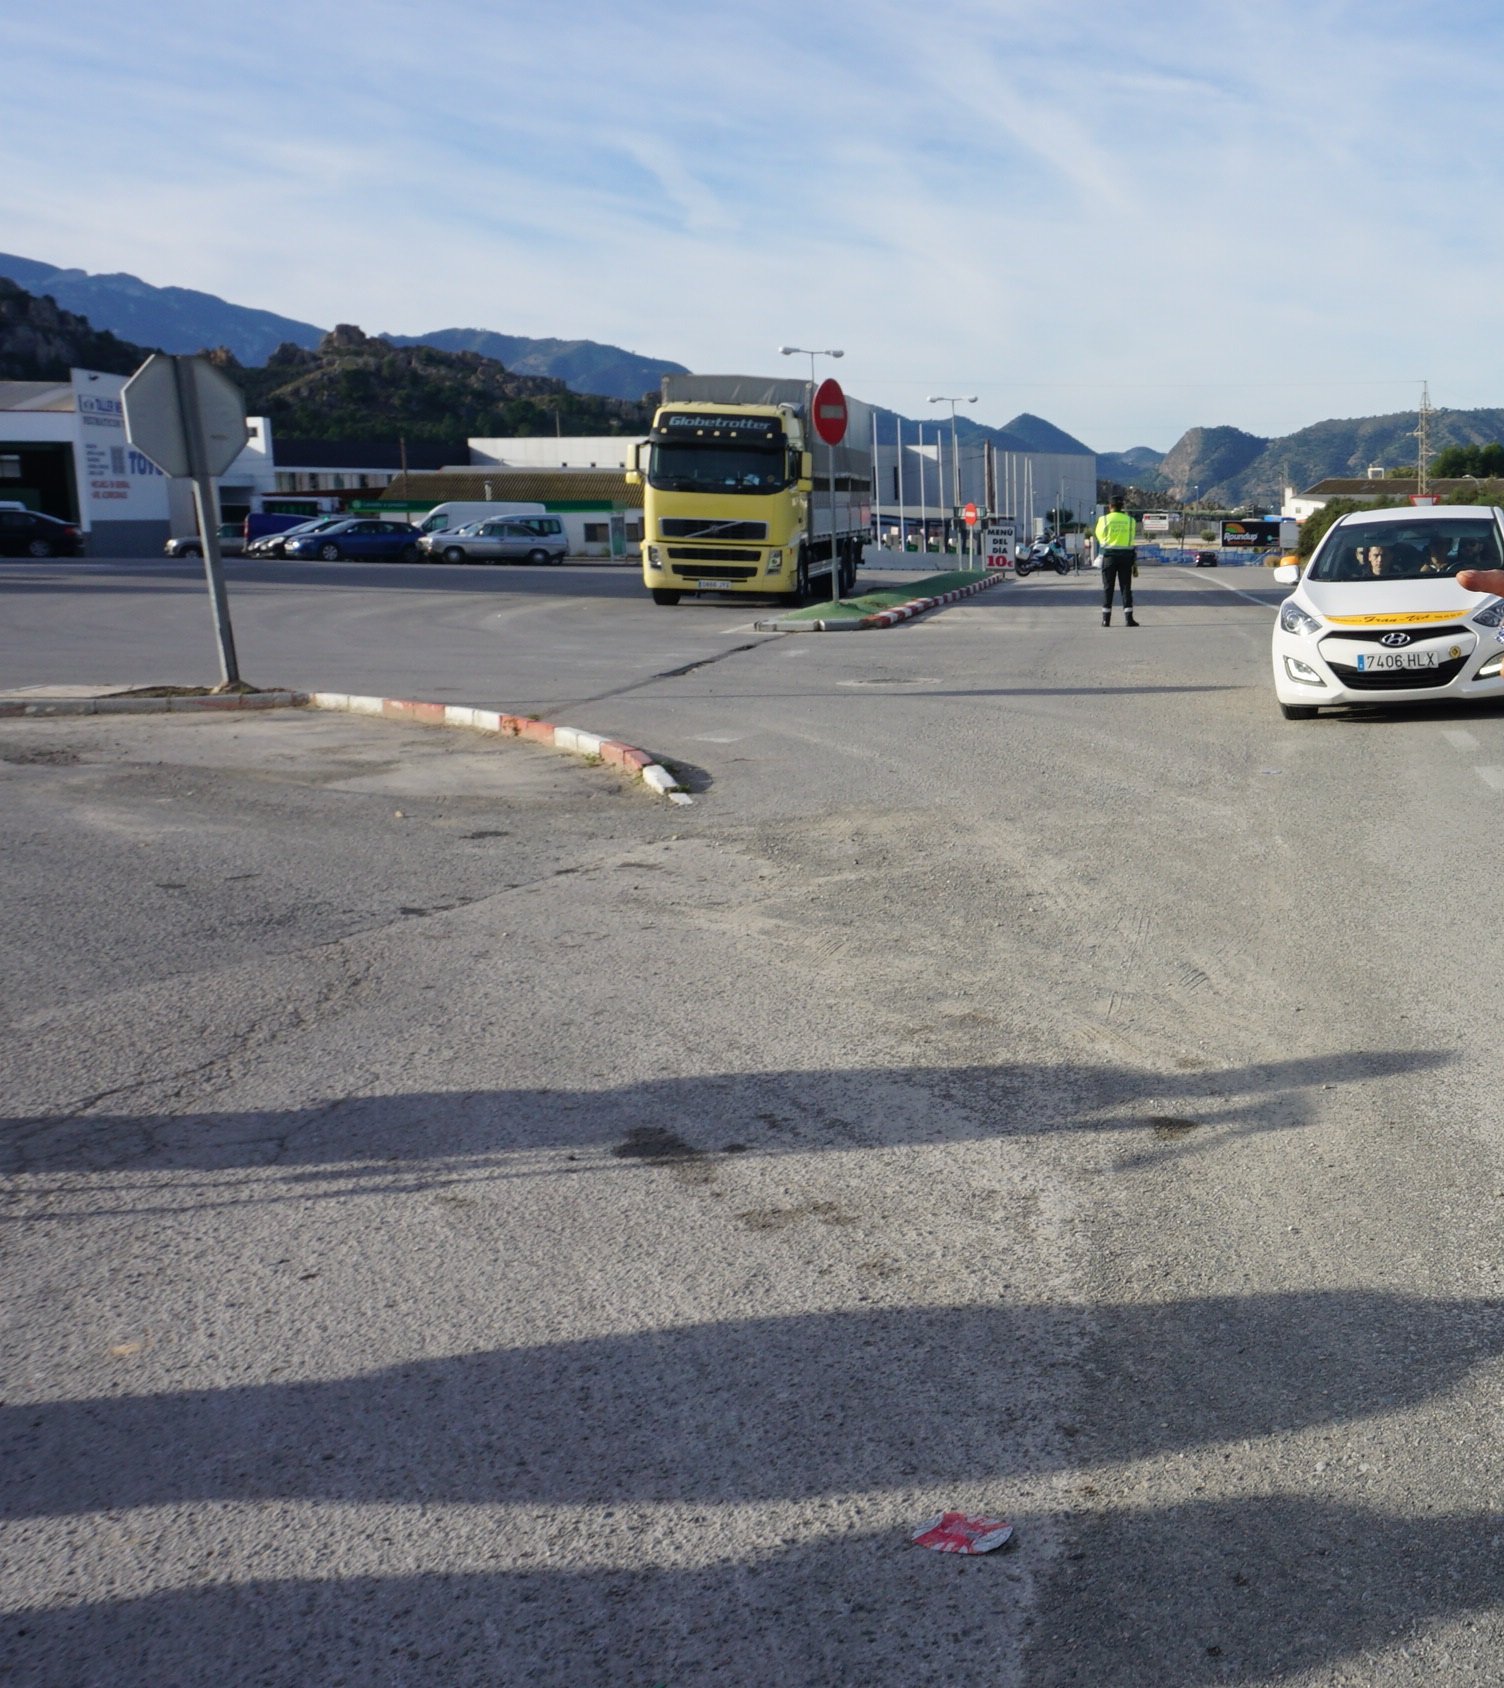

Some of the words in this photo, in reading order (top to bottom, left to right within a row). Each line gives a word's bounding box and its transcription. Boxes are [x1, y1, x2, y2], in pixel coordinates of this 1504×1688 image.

[668, 415, 772, 431] Globetrotter
[1223, 531, 1258, 543] Roundup
[1366, 654, 1403, 669] 7406
[1407, 653, 1435, 668] HLX
